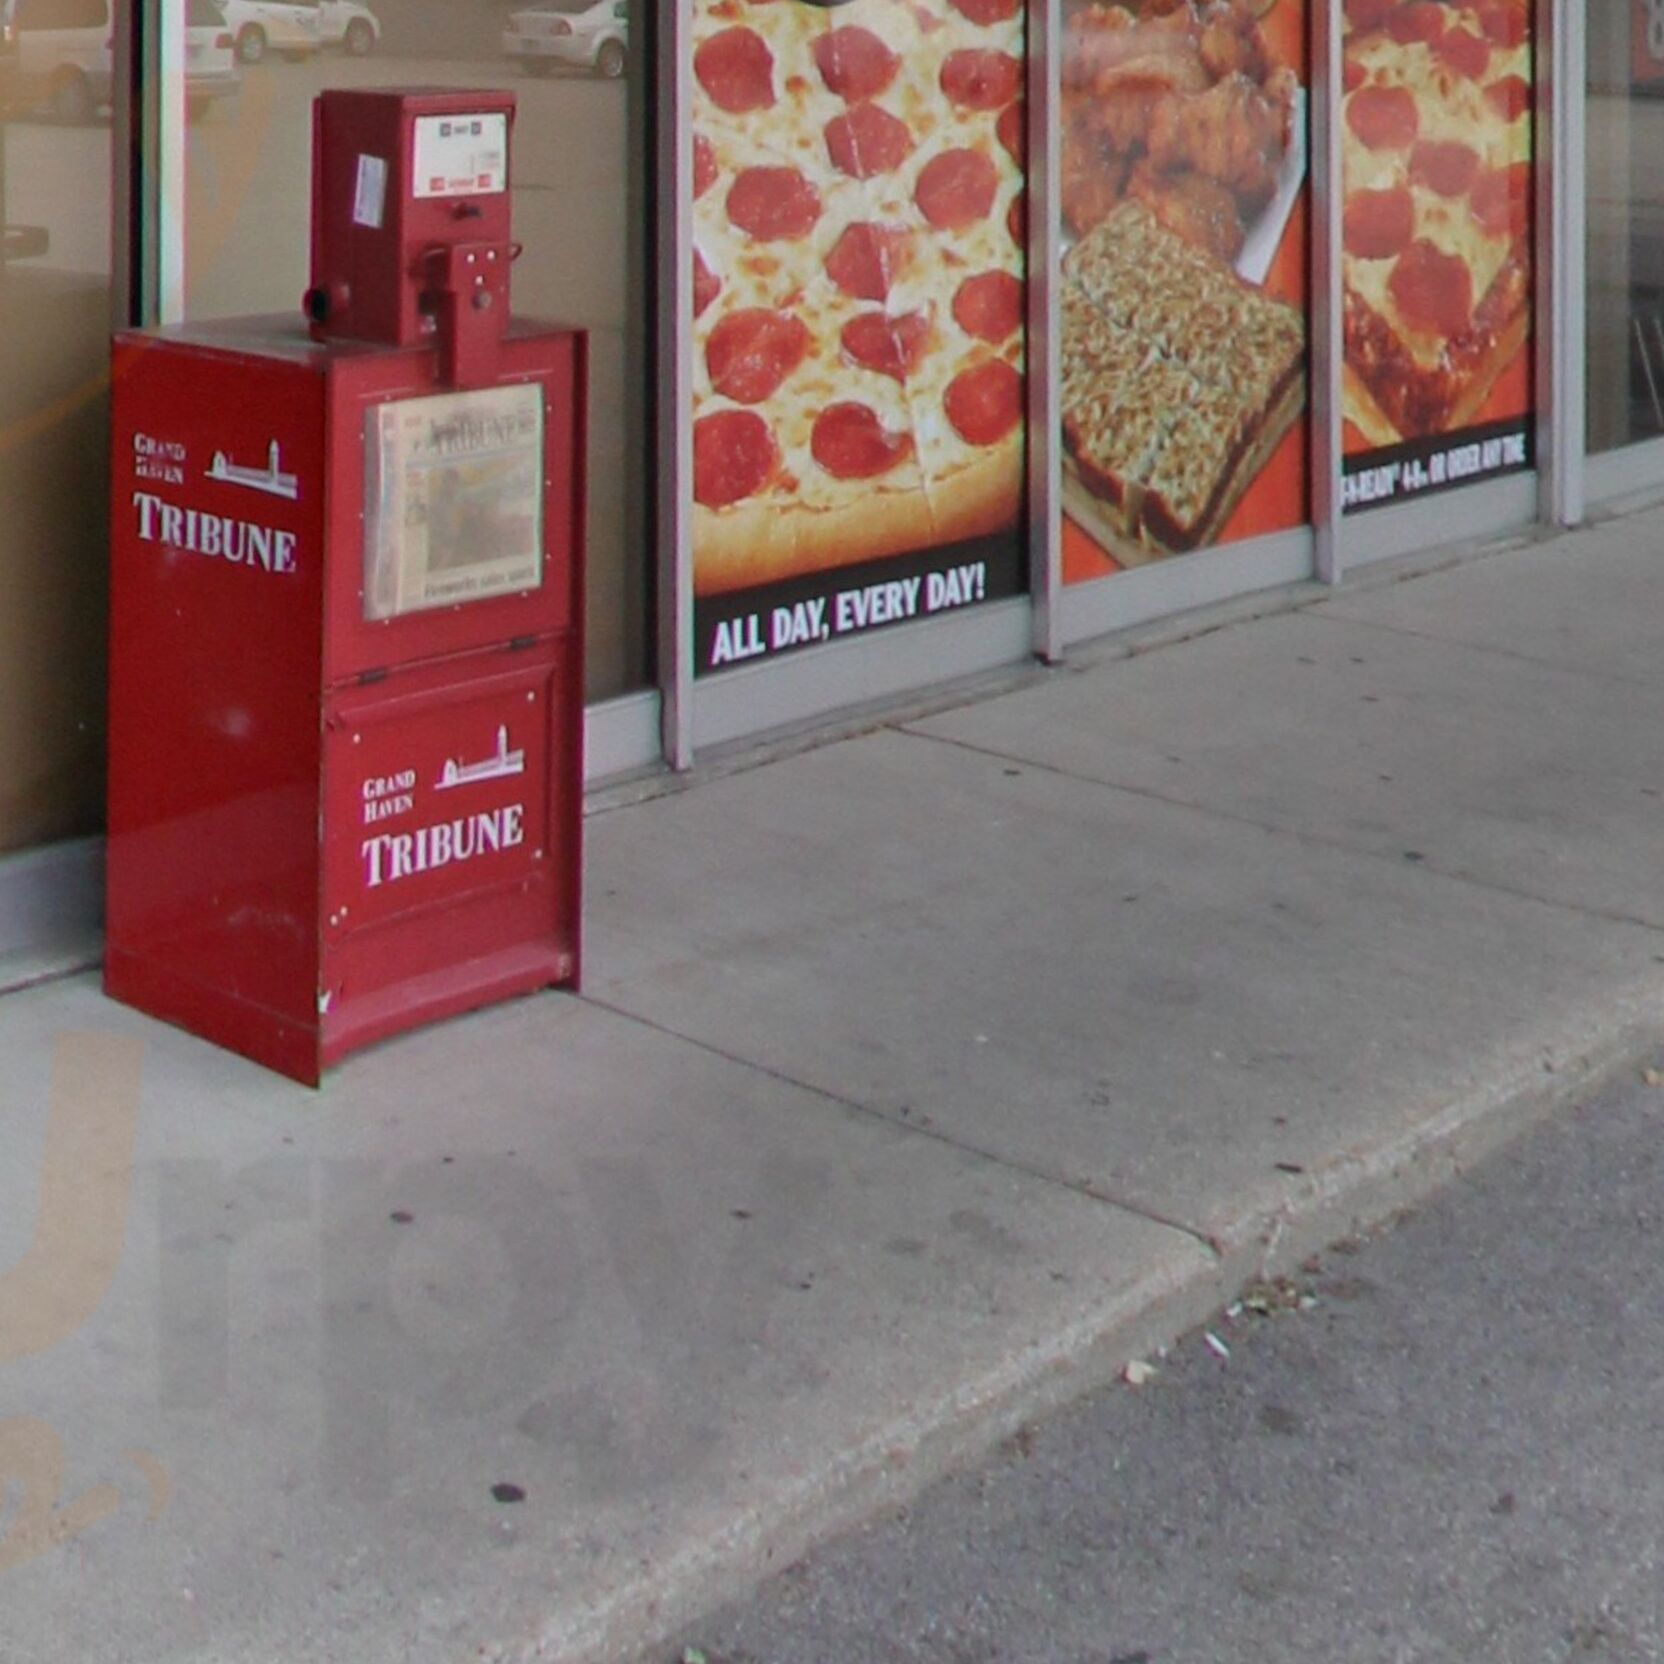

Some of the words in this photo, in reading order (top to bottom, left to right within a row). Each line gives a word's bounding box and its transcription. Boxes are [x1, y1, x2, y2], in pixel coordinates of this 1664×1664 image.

[133, 432, 186, 461] GRAND
[132, 491, 297, 573] TRIBUNE
[711, 613, 766, 666] ALL
[772, 596, 830, 642] DAY,
[835, 576, 921, 633] EVERY
[926, 561, 986, 612] DAY!
[362, 768, 416, 800] GRAND
[363, 792, 414, 824] HAVEN
[361, 802, 524, 888] TRIBUNE
